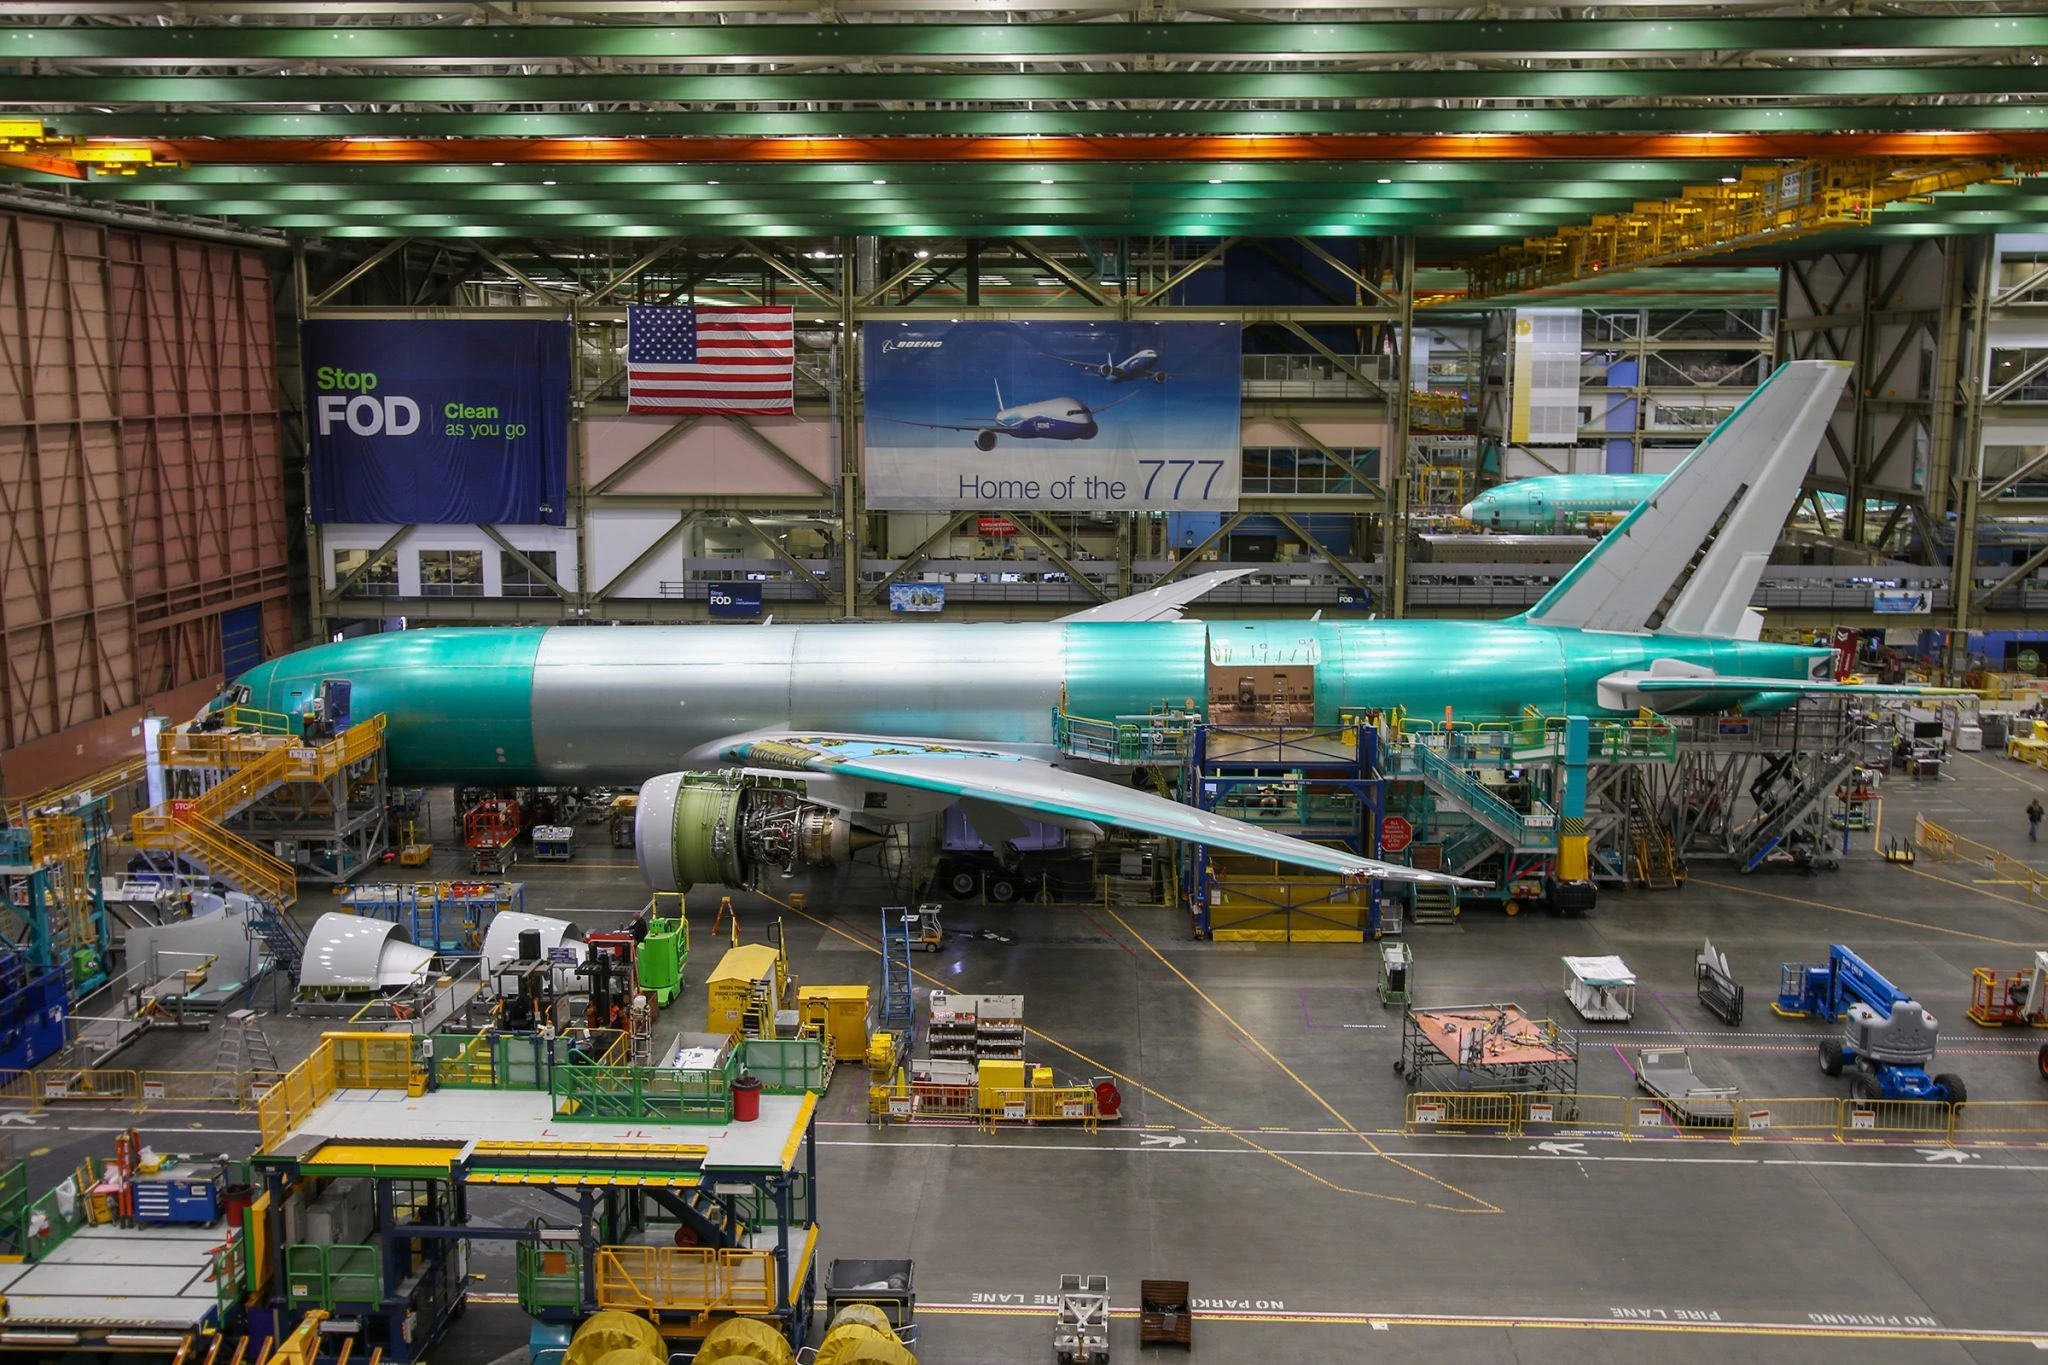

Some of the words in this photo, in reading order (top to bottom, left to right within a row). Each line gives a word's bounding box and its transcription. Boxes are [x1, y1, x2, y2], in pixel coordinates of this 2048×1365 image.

[317, 366, 378, 395] Stop
[318, 395, 421, 437] FOD
[444, 403, 499, 419] Clean
[445, 423, 465, 436] as
[470, 423, 500, 439] you
[505, 424, 526, 440] go
[959, 475, 1041, 500] Home
[1050, 475, 1077, 500] of
[1084, 475, 1127, 500] the
[1138, 459, 1225, 501] 777
[710, 596, 732, 605] FOD
[1339, 596, 1354, 604] FOD
[971, 1292, 1025, 1304] LANE
[1191, 1298, 1250, 1309] PARKI
[1256, 1300, 1284, 1310] NO
[1610, 1307, 1667, 1319] LANE
[1674, 1309, 1722, 1321] FIRE
[1807, 1313, 1902, 1325] PARKING
[1904, 1315, 1937, 1327] NO
